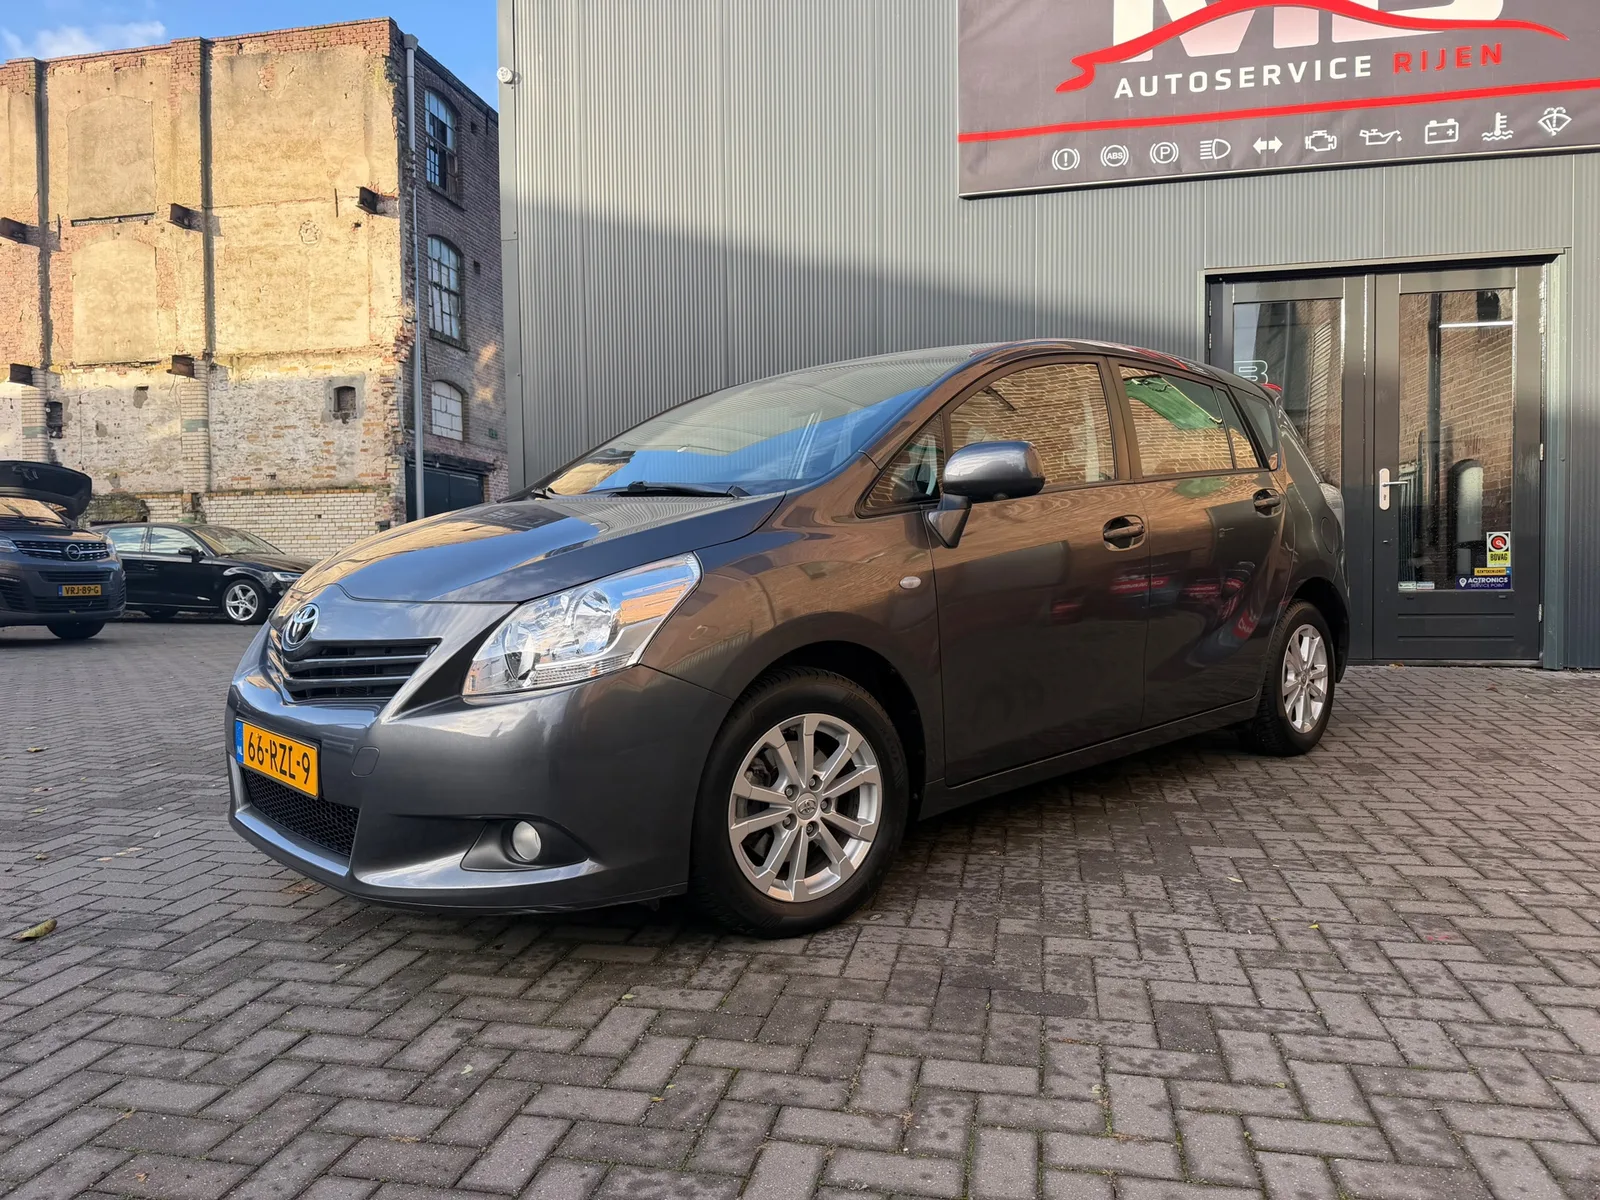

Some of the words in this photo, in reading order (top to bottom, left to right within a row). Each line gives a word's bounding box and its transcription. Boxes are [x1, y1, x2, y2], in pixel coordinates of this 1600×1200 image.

[1114, 55, 1372, 98] AUTOSERVICE
[1392, 43, 1503, 74] RIJEN
[1106, 151, 1124, 160] ABS
[1490, 553, 1508, 561] BOVAG
[65, 586, 99, 594] VRJ-89-G
[248, 732, 311, 785] 66-RZL-9
